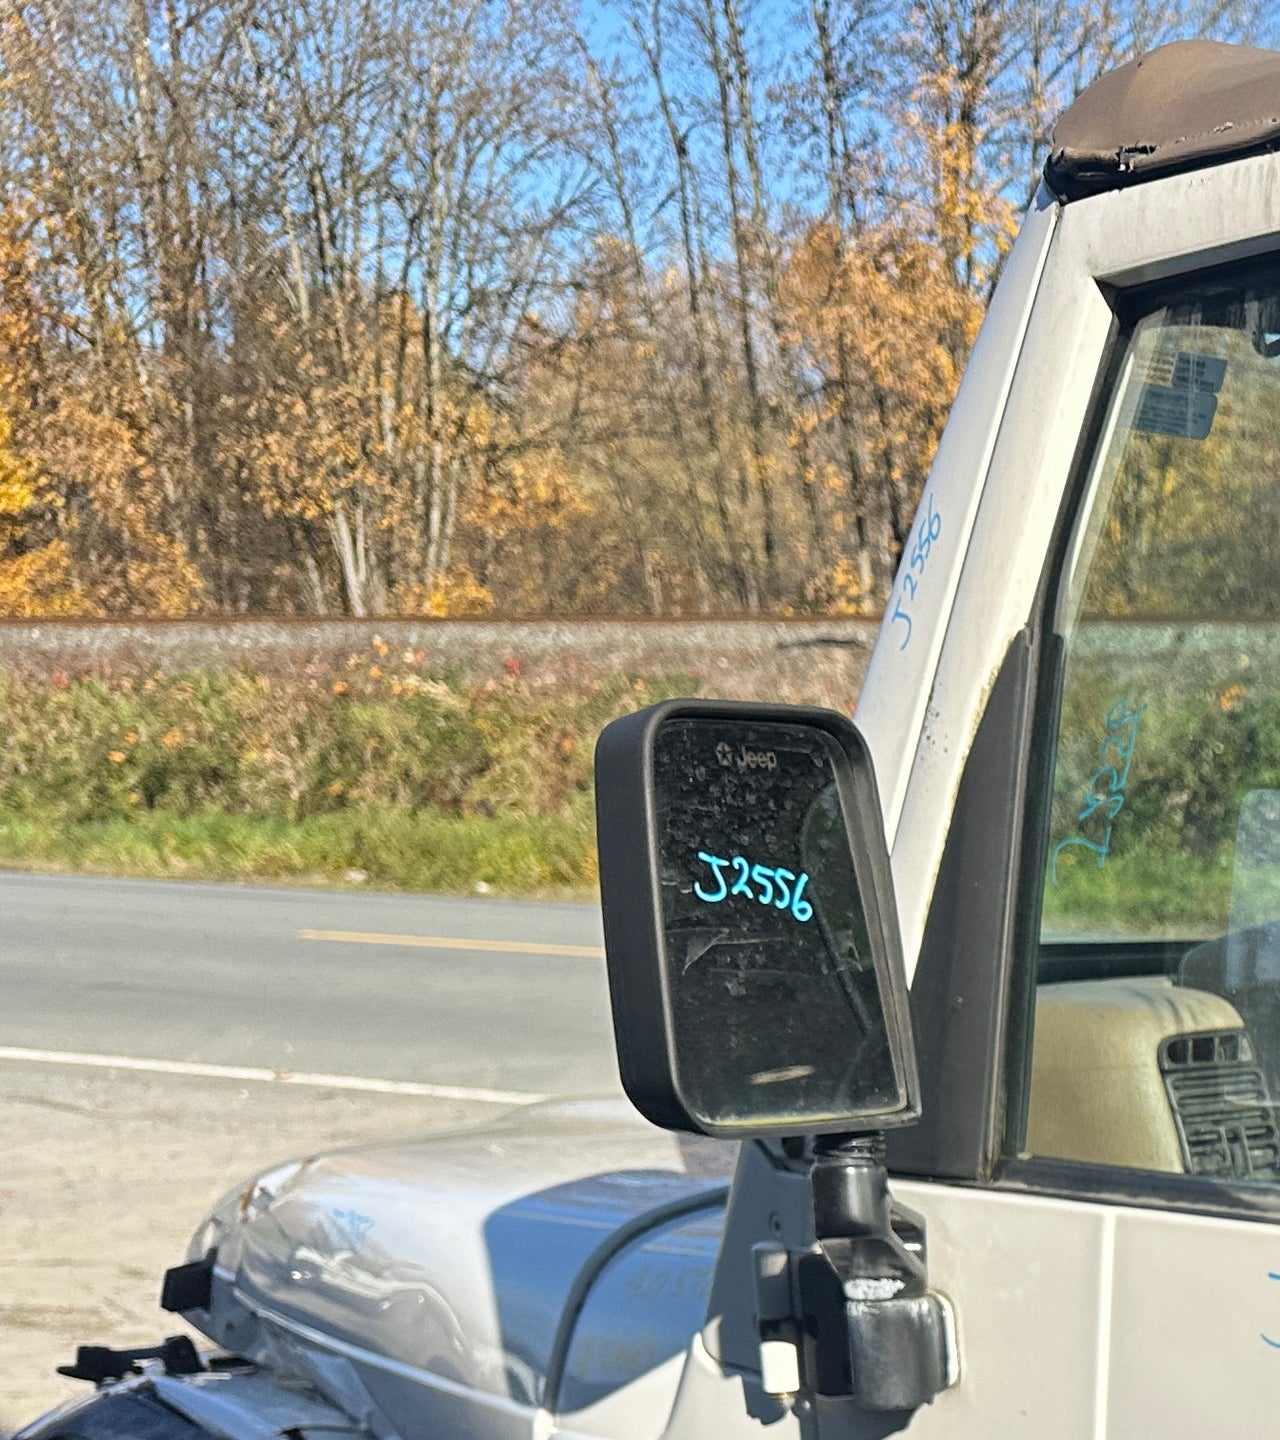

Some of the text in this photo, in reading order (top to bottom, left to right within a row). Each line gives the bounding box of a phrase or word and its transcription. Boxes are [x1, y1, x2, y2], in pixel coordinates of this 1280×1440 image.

[891, 494, 942, 651] J2556
[735, 743, 777, 772] Jeep
[694, 852, 814, 922] J2556
